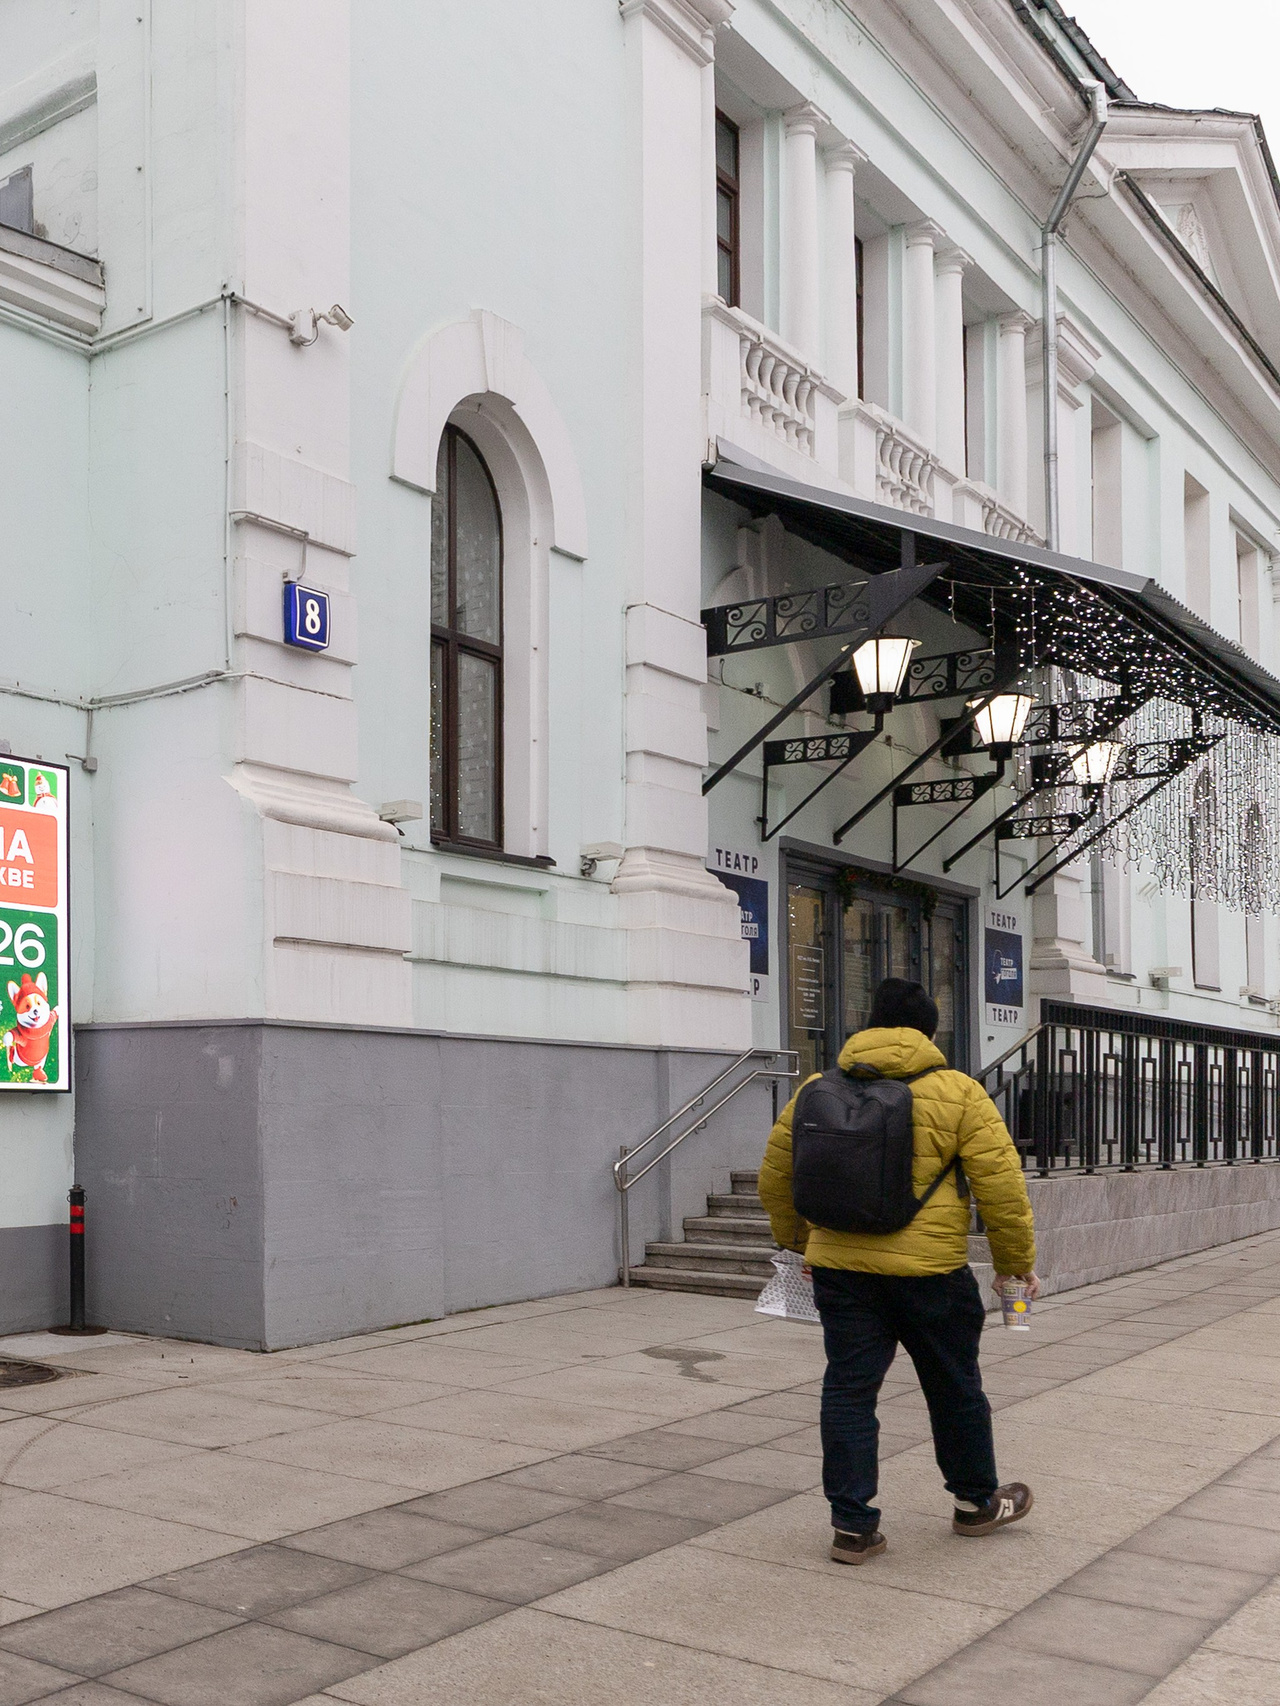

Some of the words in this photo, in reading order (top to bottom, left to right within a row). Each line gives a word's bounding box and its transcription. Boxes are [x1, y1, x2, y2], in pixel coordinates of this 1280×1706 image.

[305, 598, 321, 634] 8
[716, 848, 759, 874] ТЕАТР
[991, 912, 1017, 930] ТЕАТР
[741, 924, 758, 937] ГОЛЯ
[1000, 958, 1014, 967] ТЕАТР
[992, 1008, 1018, 1024] ТЕАТР
